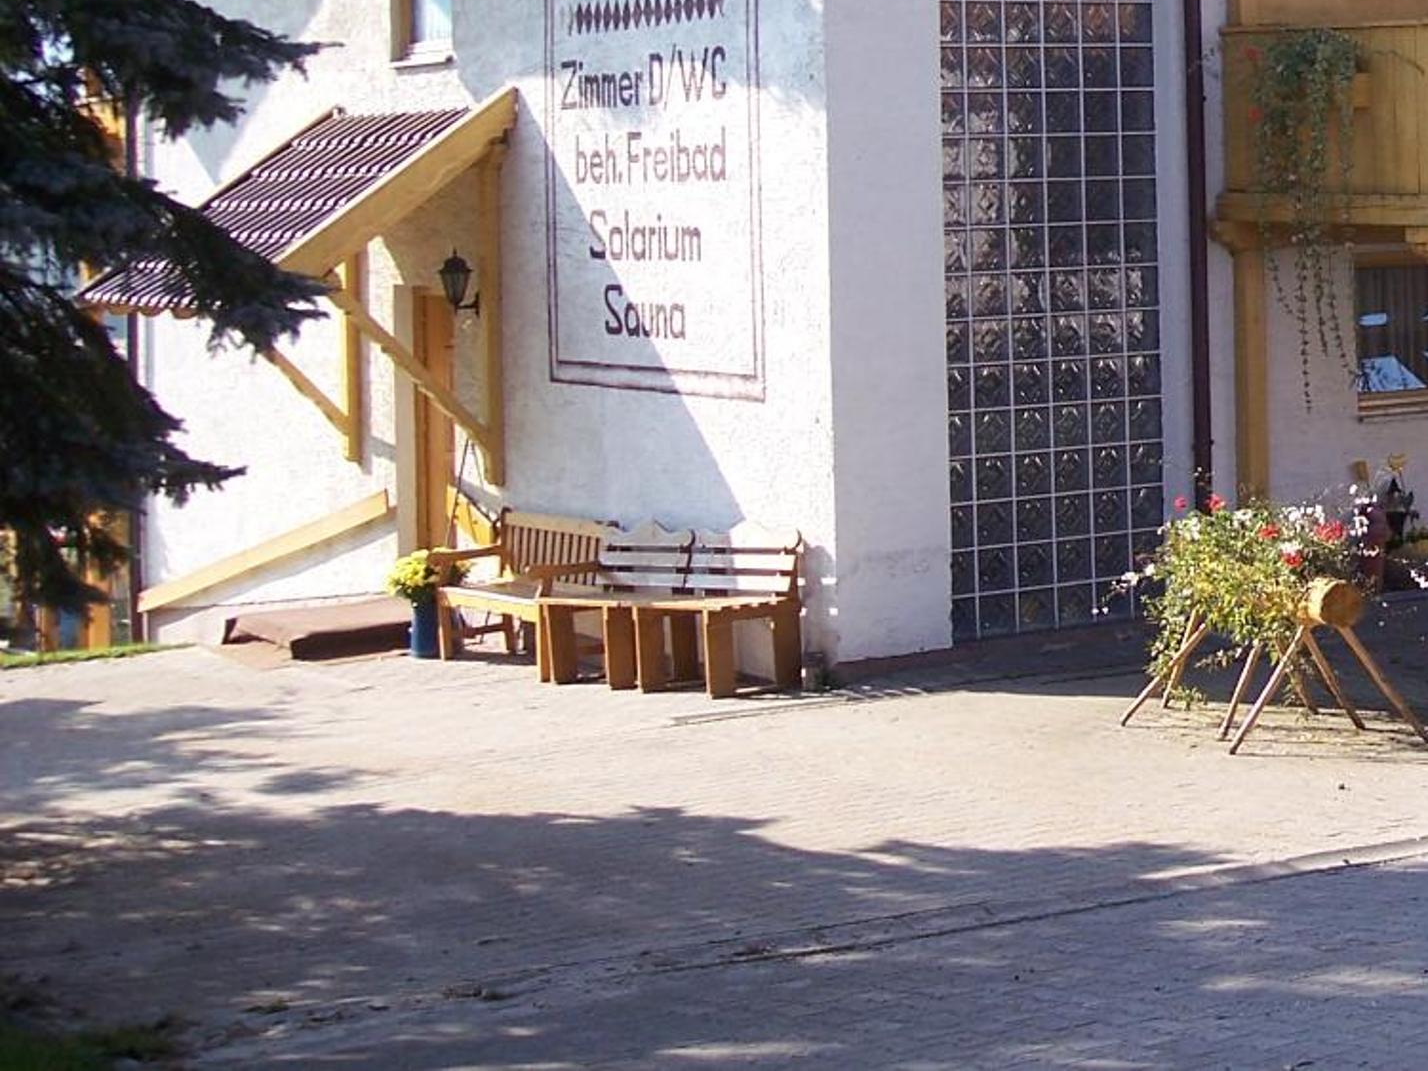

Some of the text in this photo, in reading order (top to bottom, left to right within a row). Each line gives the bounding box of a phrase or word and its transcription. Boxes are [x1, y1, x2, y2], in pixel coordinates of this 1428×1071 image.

[560, 43, 727, 111] Zimmer D/WC
[626, 125, 728, 186] Freibad
[589, 208, 702, 262] Solarium
[604, 283, 687, 340] Sauna
